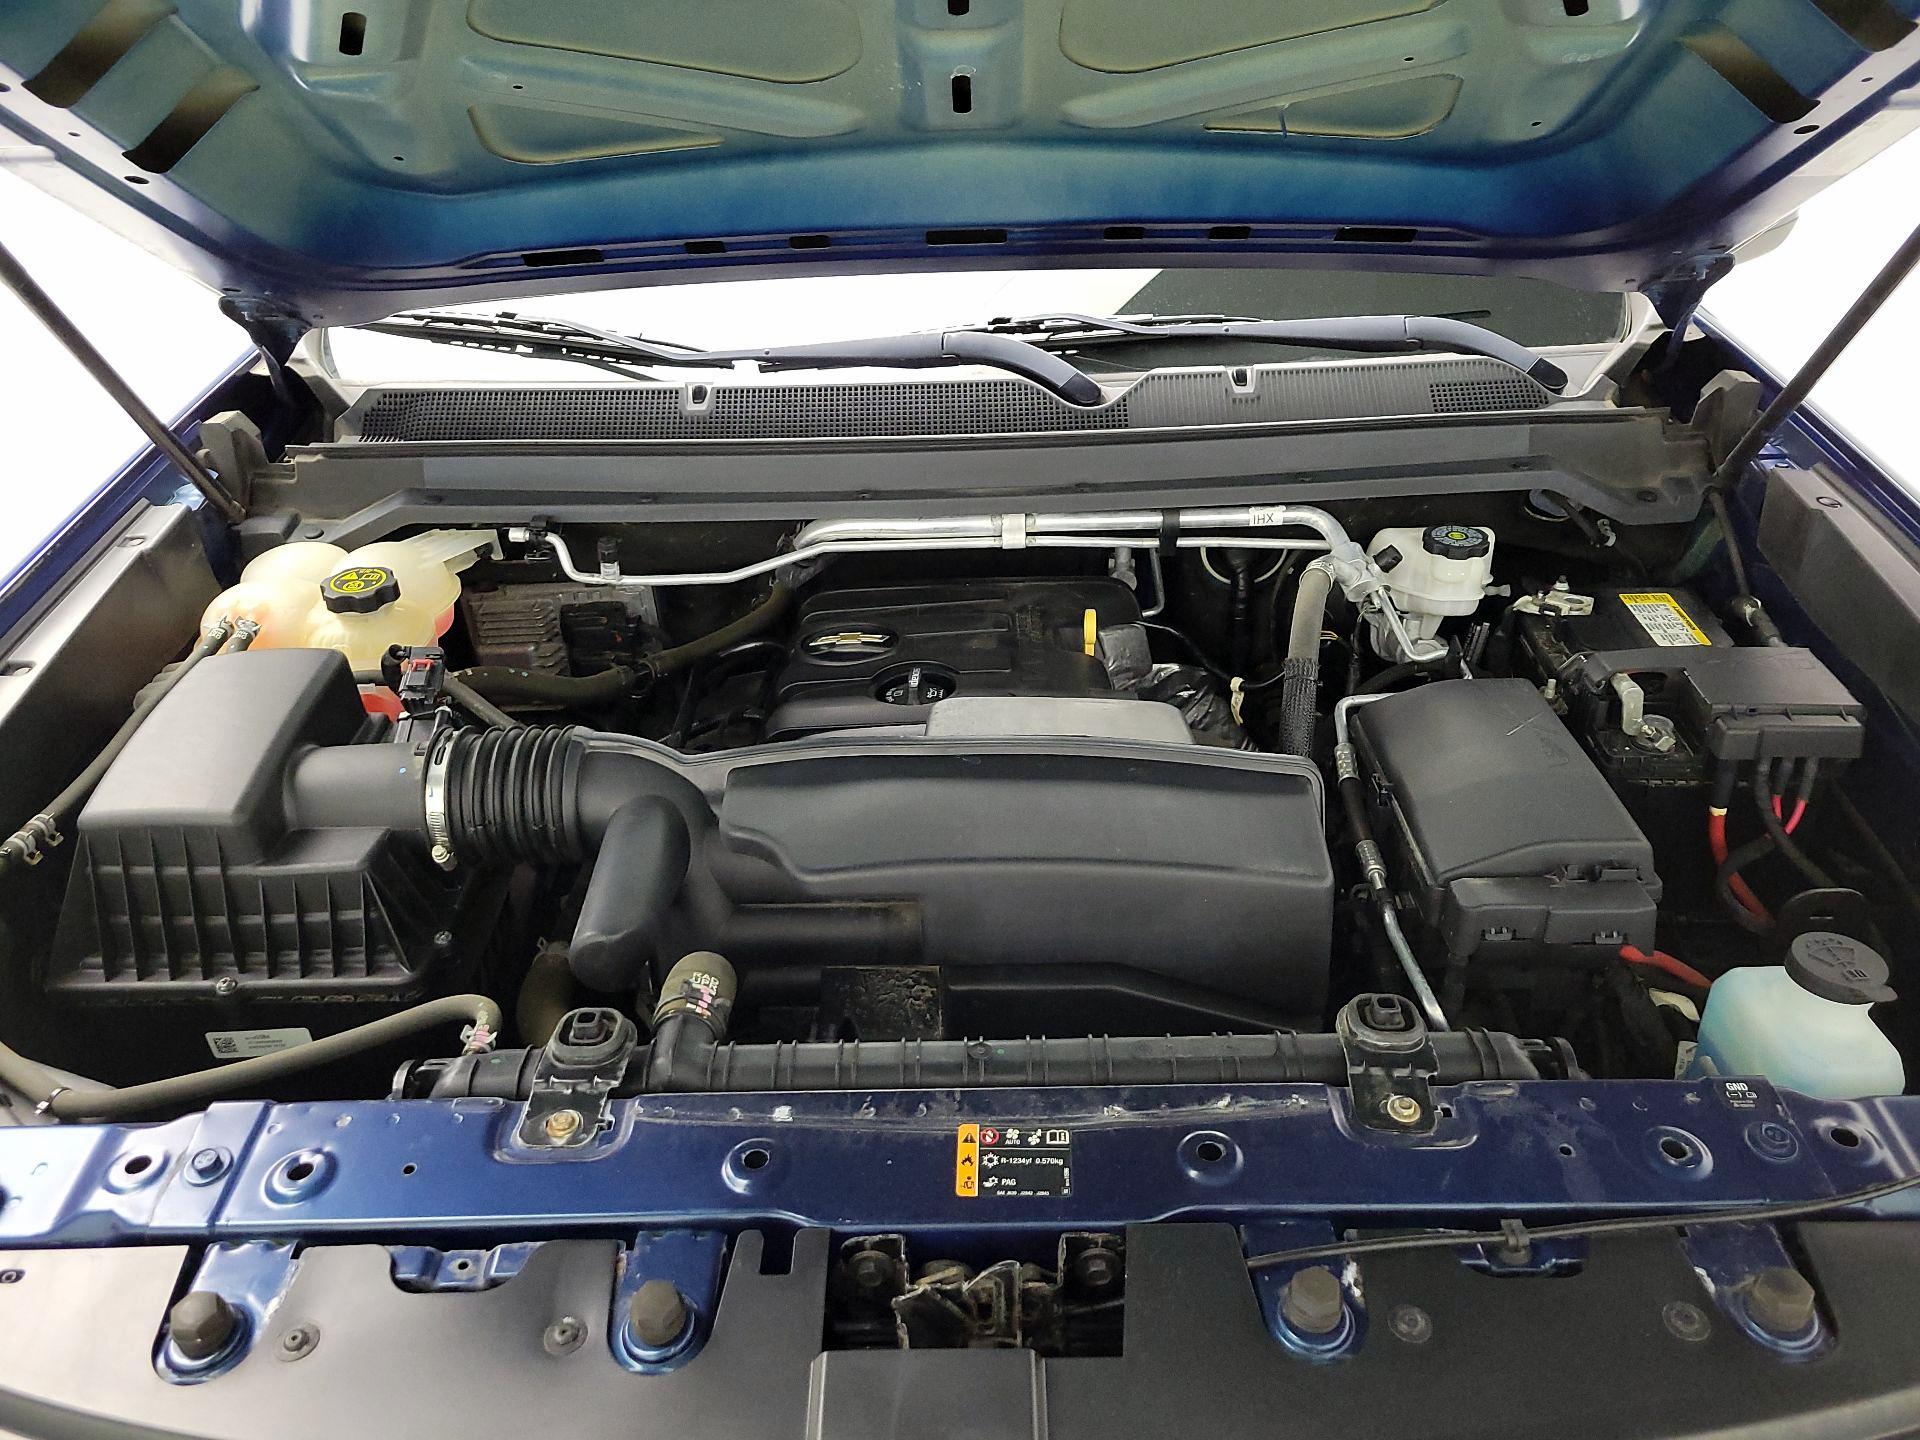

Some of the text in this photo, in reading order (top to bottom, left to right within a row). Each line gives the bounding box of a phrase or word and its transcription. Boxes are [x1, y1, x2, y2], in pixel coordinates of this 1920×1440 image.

[1253, 513, 1274, 525] IHX
[1725, 1082, 1749, 1091] GND
[1005, 1138, 1021, 1146] AUTO
[1000, 1157, 1064, 1165] R-1234yf 0.570kg
[1001, 1178, 1017, 1186] PAG
